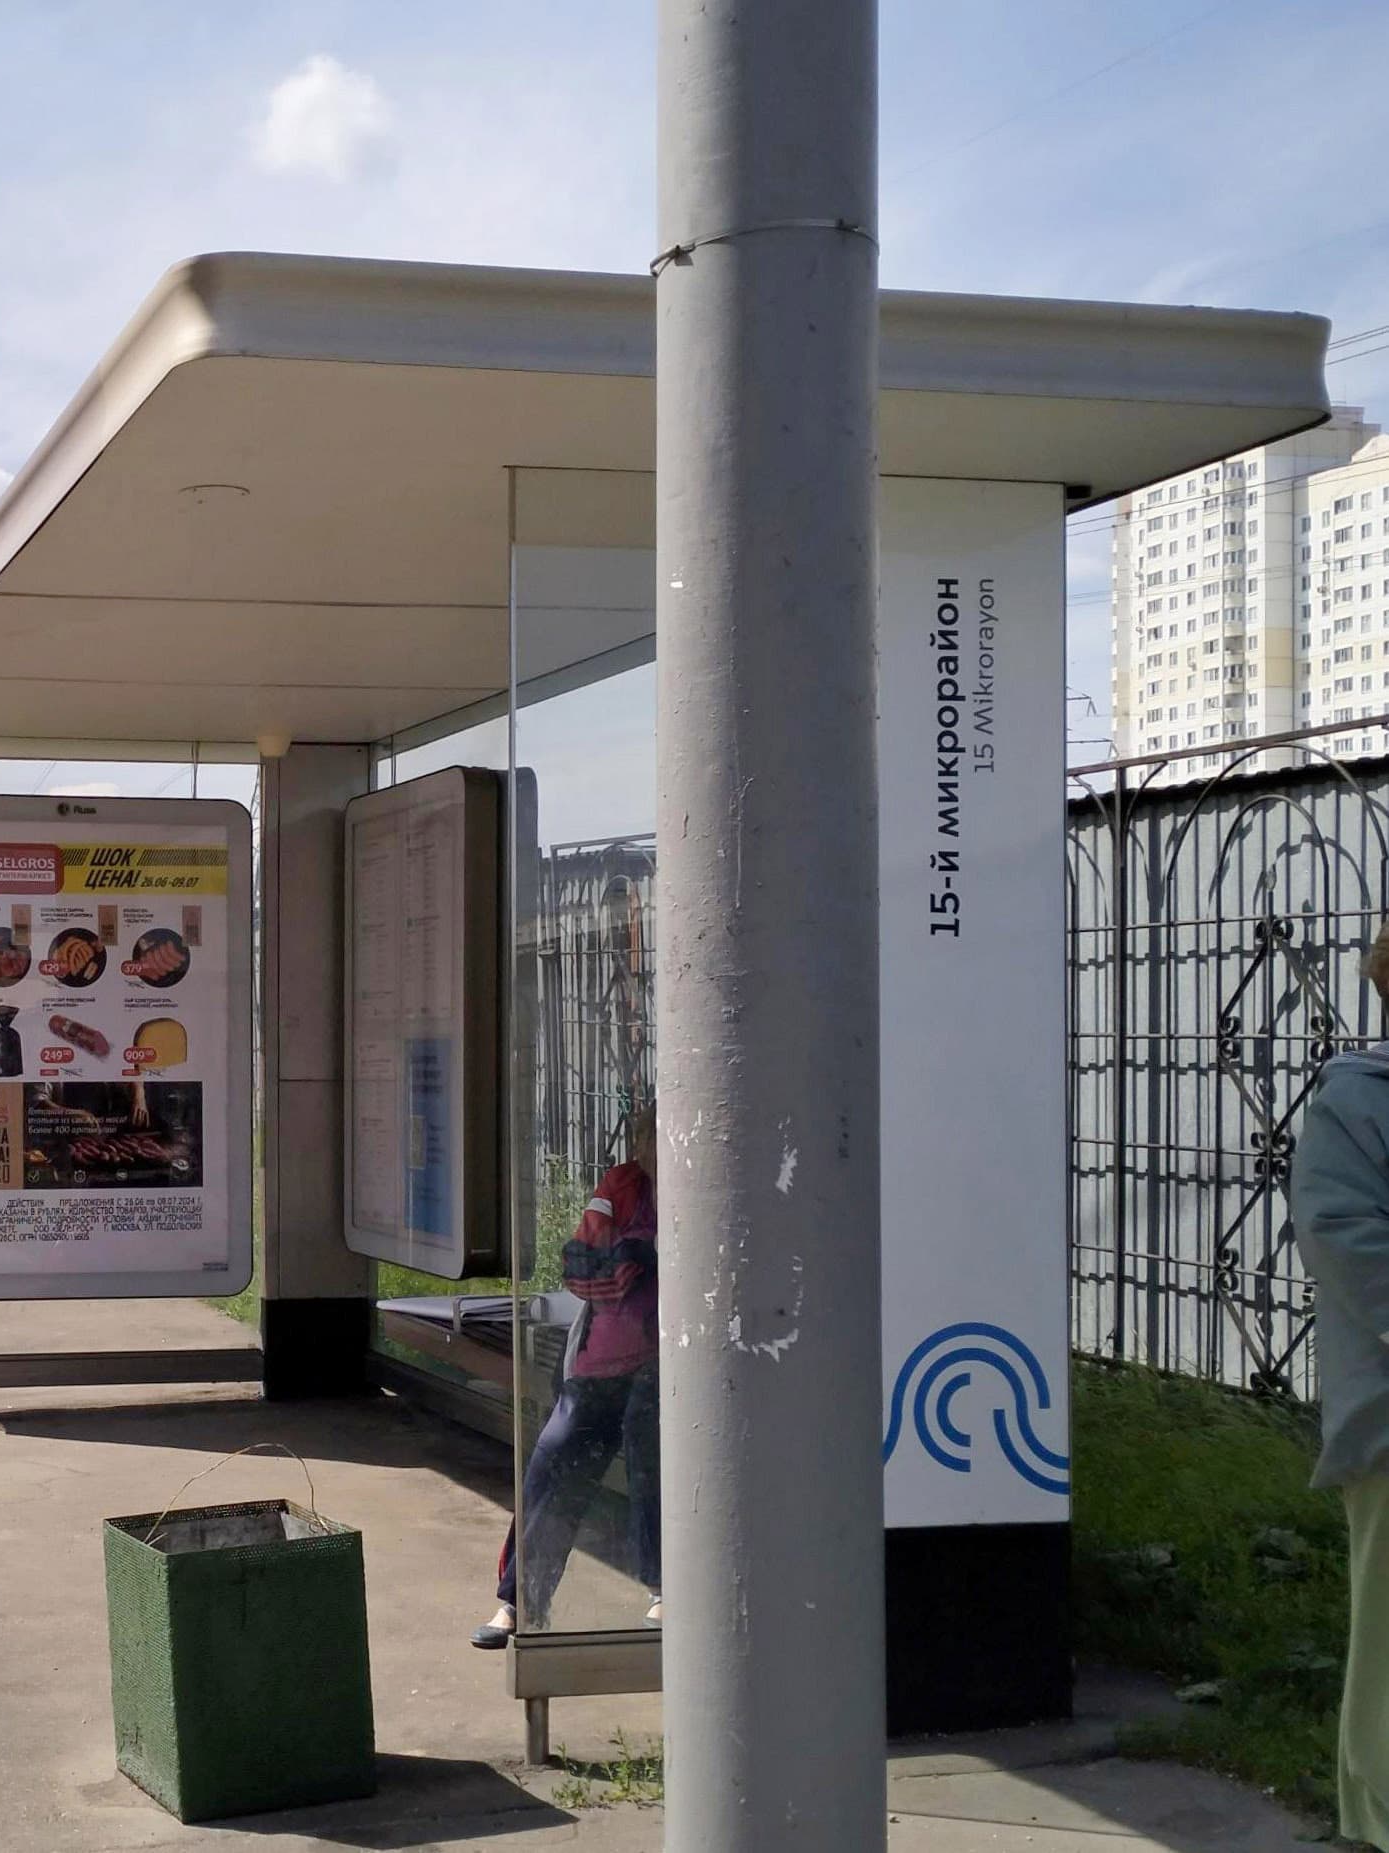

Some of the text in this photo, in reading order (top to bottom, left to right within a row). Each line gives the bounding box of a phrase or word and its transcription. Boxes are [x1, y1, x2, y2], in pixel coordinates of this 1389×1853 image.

[973, 577, 999, 773] 15 Mikrorayon
[929, 577, 966, 937] 15-й микрорайон
[73, 806, 97, 815] Russ
[89, 848, 137, 867] ШОК
[85, 869, 142, 890] ЦЕНА!
[43, 1050, 63, 1061] 249
[125, 1050, 145, 1061] 909
[54, 1125, 71, 1134] 400
[33, 1224, 50, 1233] ООО
